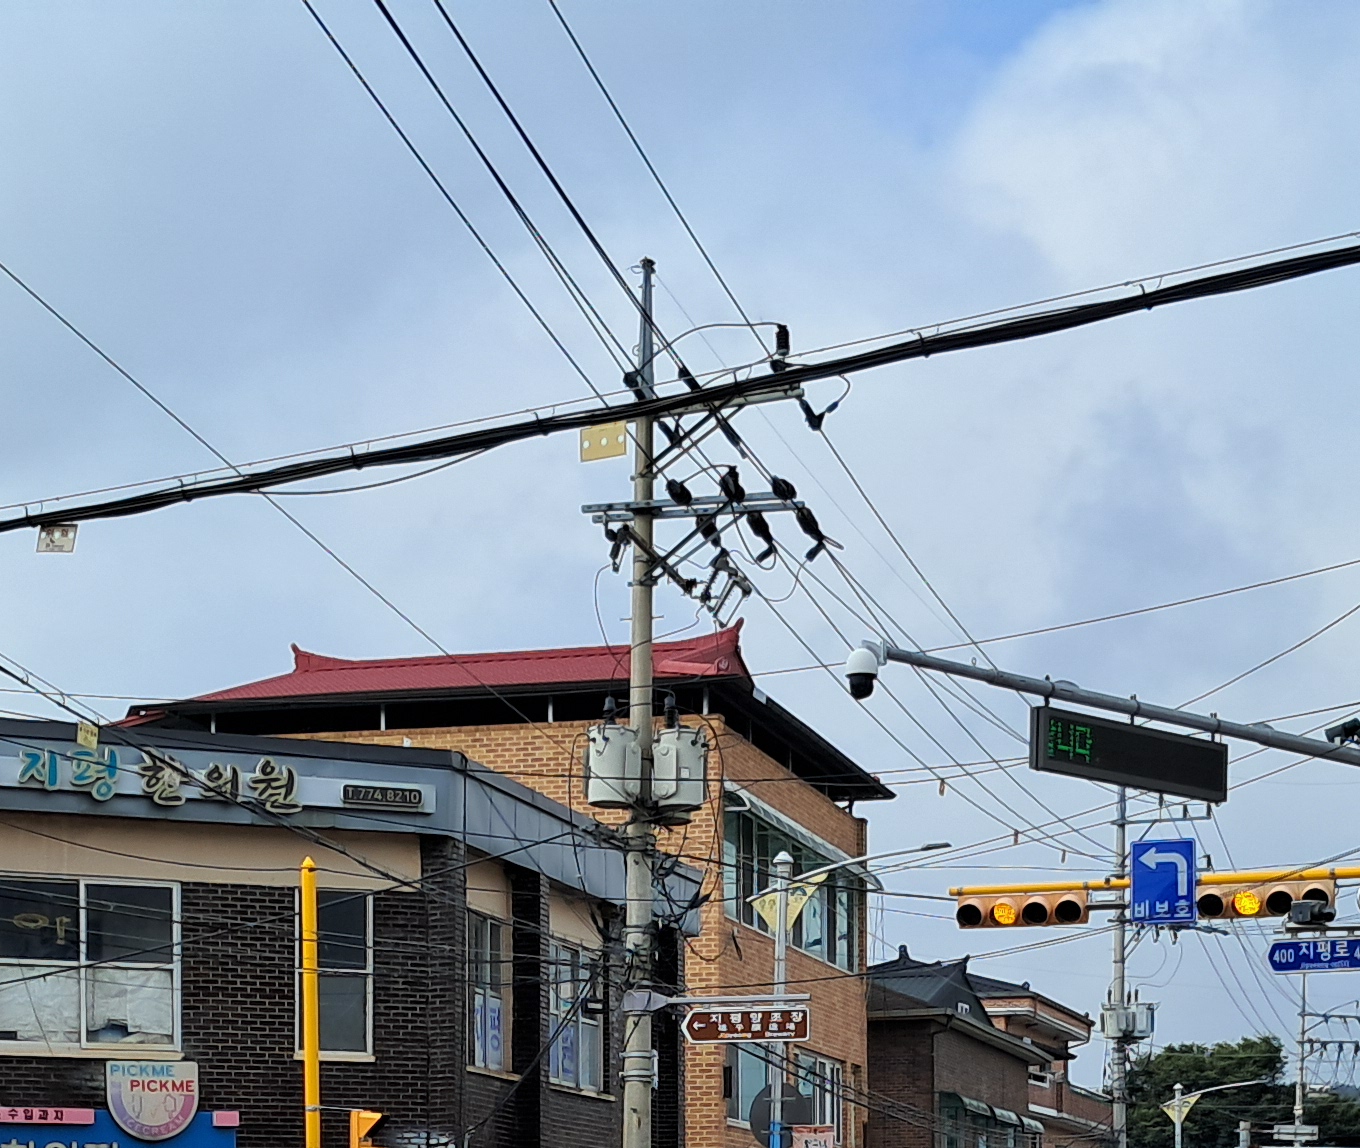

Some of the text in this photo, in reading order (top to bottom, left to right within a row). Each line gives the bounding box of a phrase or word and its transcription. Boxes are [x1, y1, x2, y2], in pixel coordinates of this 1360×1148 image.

[1134, 900, 1194, 919] 비보호
[1273, 949, 1295, 963] 400
[1299, 941, 1350, 961] 지평로
[110, 1064, 175, 1077] PICKME
[129, 1079, 194, 1092] PICKME
